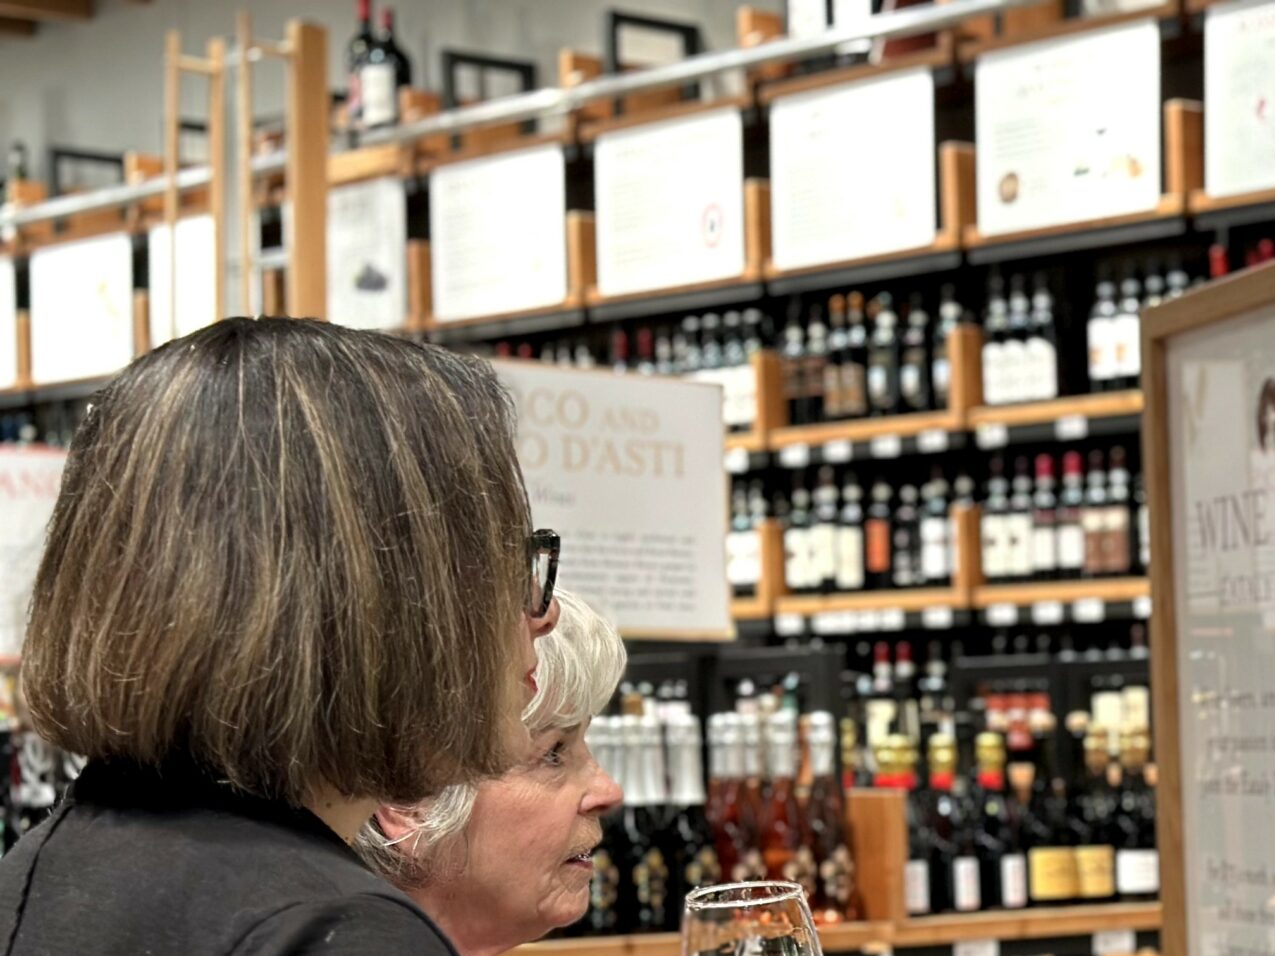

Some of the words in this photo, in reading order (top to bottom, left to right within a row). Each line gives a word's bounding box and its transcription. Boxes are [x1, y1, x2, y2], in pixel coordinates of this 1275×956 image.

[516, 385, 590, 431] CO
[603, 405, 662, 433] AND
[560, 434, 685, 479] D'ASTI
[1194, 488, 1270, 553] WINE
